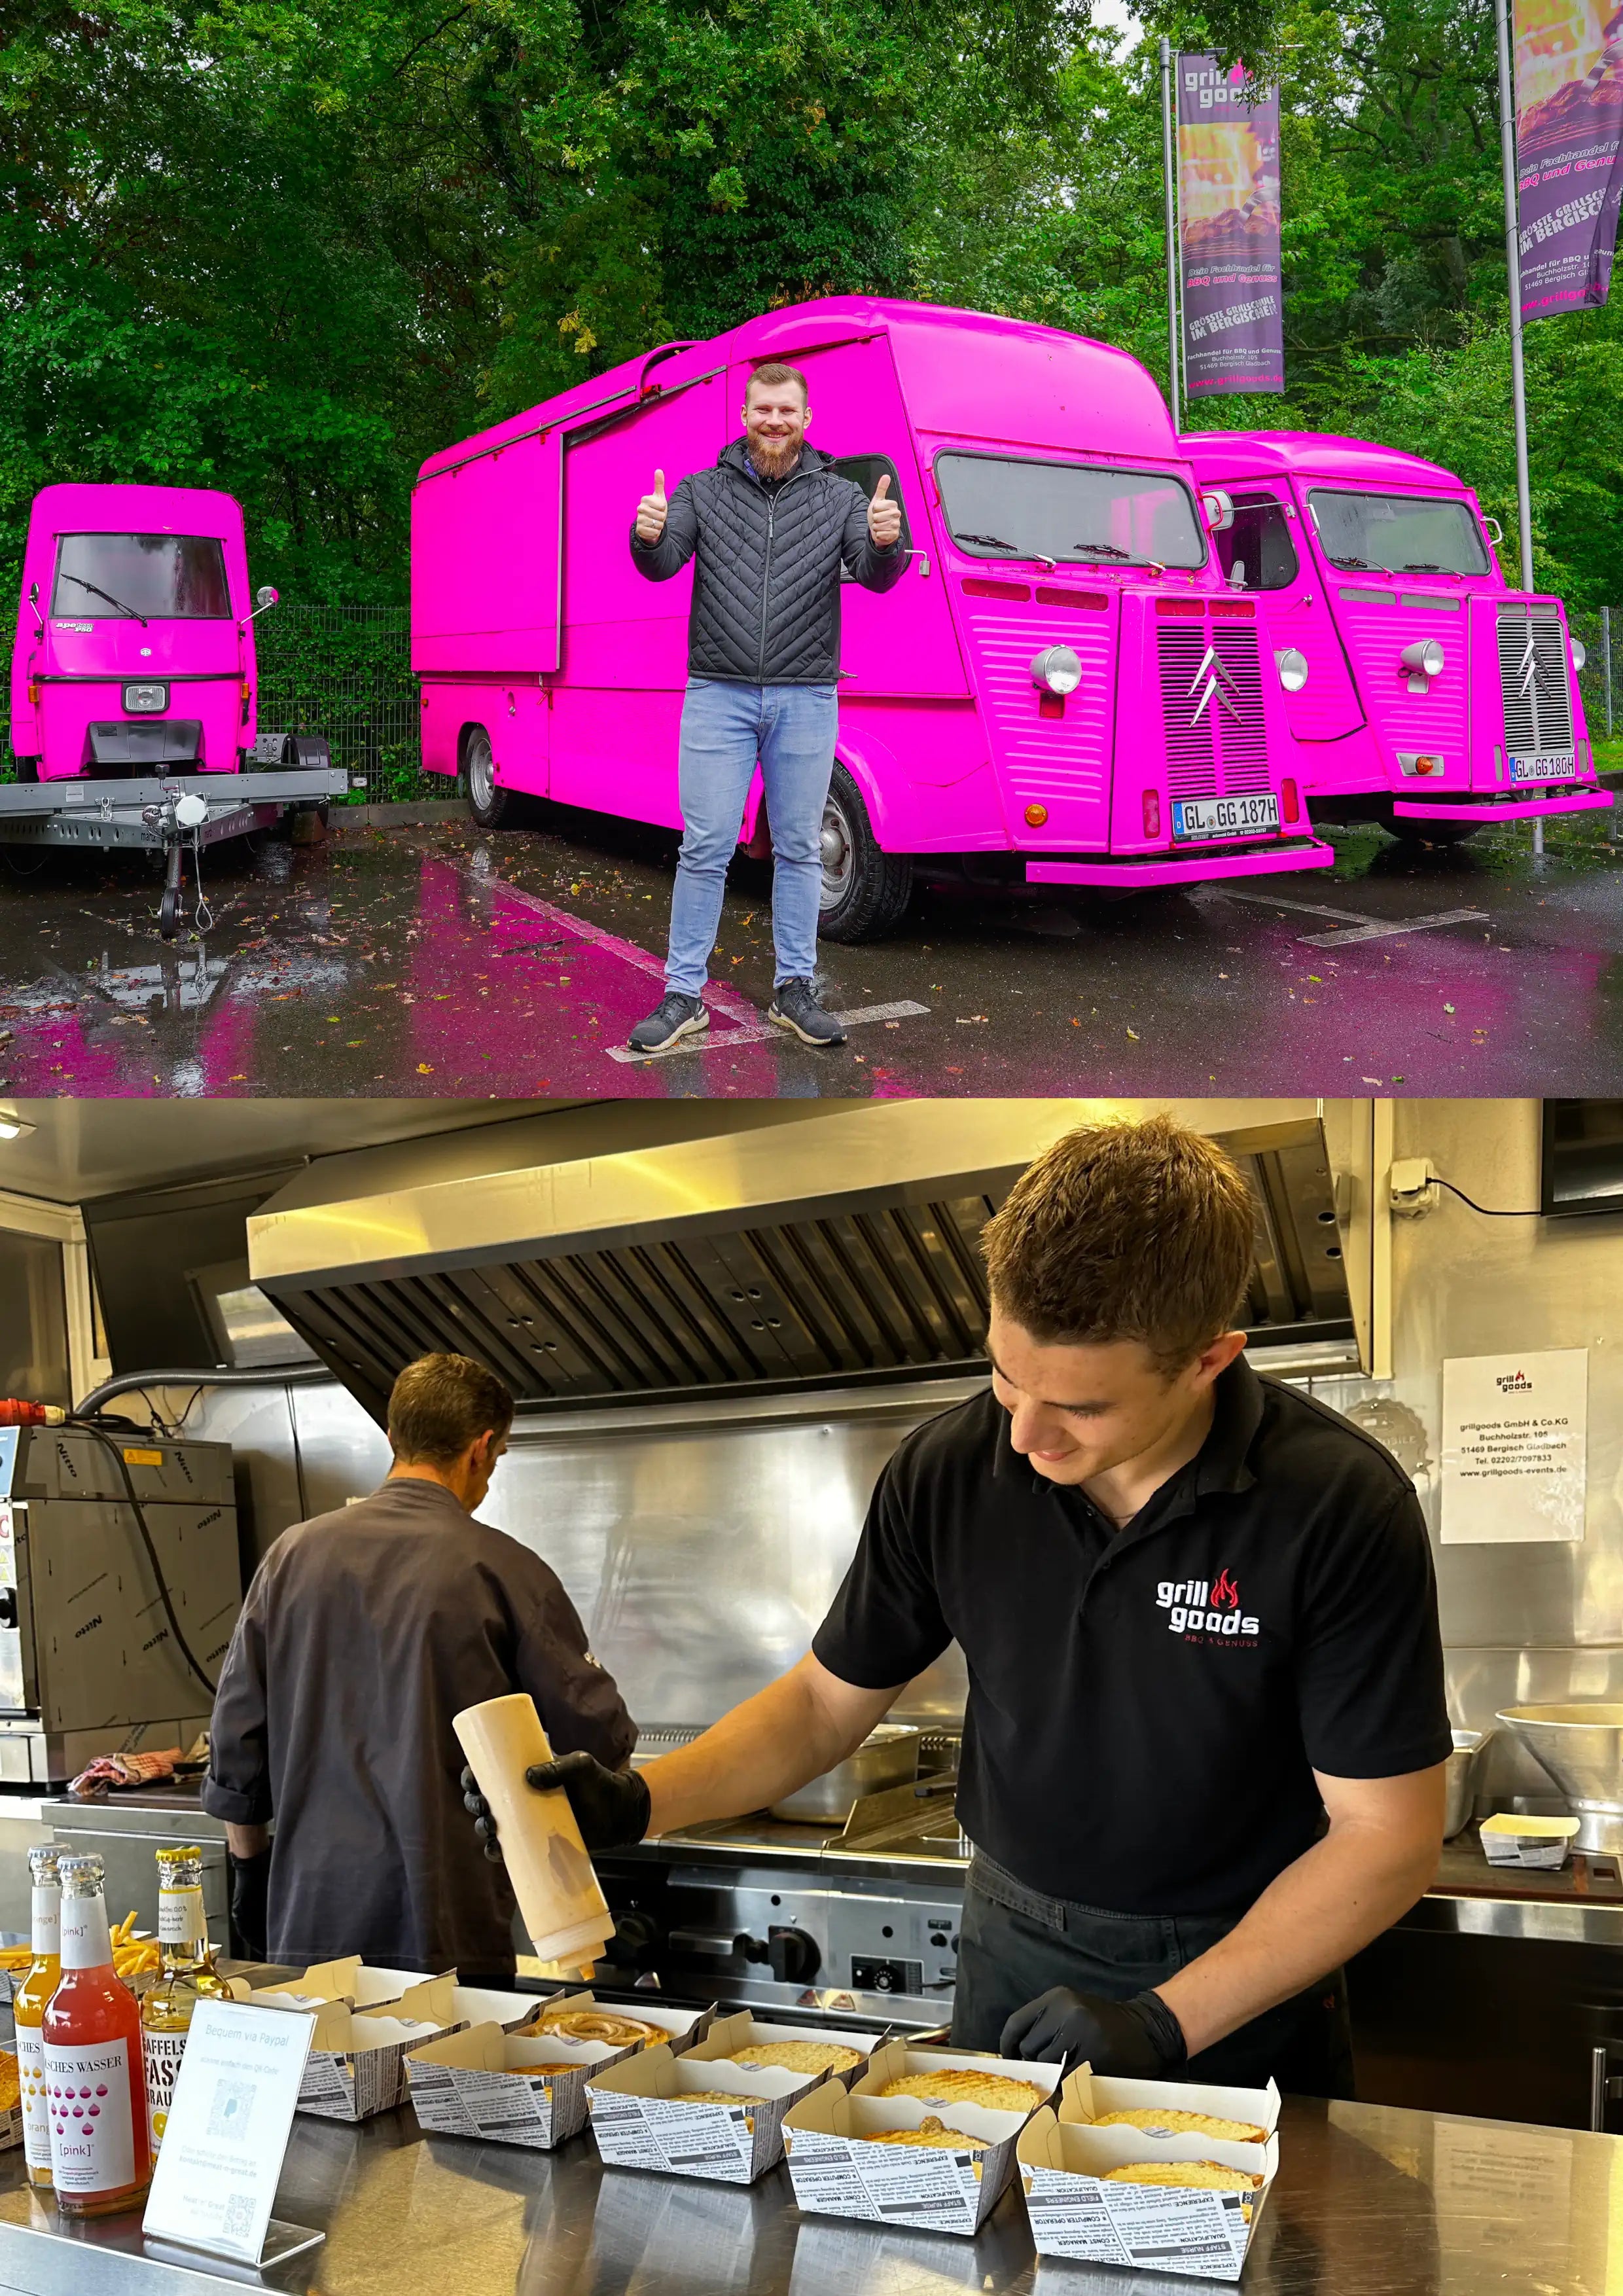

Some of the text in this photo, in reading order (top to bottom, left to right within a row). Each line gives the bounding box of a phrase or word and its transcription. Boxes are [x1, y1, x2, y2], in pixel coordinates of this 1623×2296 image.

[1520, 164, 1538, 179] Dein
[1540, 142, 1609, 169] Fachhandel
[1543, 162, 1571, 181] und
[1520, 238, 1533, 256] IM
[1563, 255, 1581, 264] BBQ
[1188, 267, 1209, 277] Dein
[1211, 264, 1260, 274] Fachhandel
[1187, 274, 1277, 288] BBQ und Genuss
[1525, 279, 1543, 291] 51469
[1544, 273, 1575, 284] Bergisch
[1189, 296, 1275, 331] GRÖSSTE GRILLSCHULE
[1190, 304, 1277, 341] IM BERGISCHEN
[1187, 350, 1221, 360] Fachhandel
[1516, 761, 1528, 778] GL
[1536, 759, 1548, 776] GG
[1185, 798, 1278, 829] GL GG 187H
[1497, 1375, 1514, 1386] grill
[1502, 1381, 1532, 1392] goods
[1460, 1422, 1501, 1432] grillgoods
[1487, 1444, 1524, 1453] Bergisch
[57, 1443, 77, 1478] Nitto
[174, 1450, 193, 1484] Nitto
[197, 1509, 222, 1530] Nitto
[1156, 1580, 1209, 1608] grill
[75, 1614, 102, 1638] Nitto
[1168, 1607, 1259, 1634] goods
[143, 1628, 168, 1651] Nitto
[1185, 1634, 1204, 1643] BBQ
[1217, 1638, 1258, 1647] GENUSS
[205, 2024, 290, 2047] Bequem via Paypal
[77, 2056, 122, 2073] WASSER
[943, 2199, 961, 2208] STAFF
[1205, 2244, 1226, 2252] STAFF
